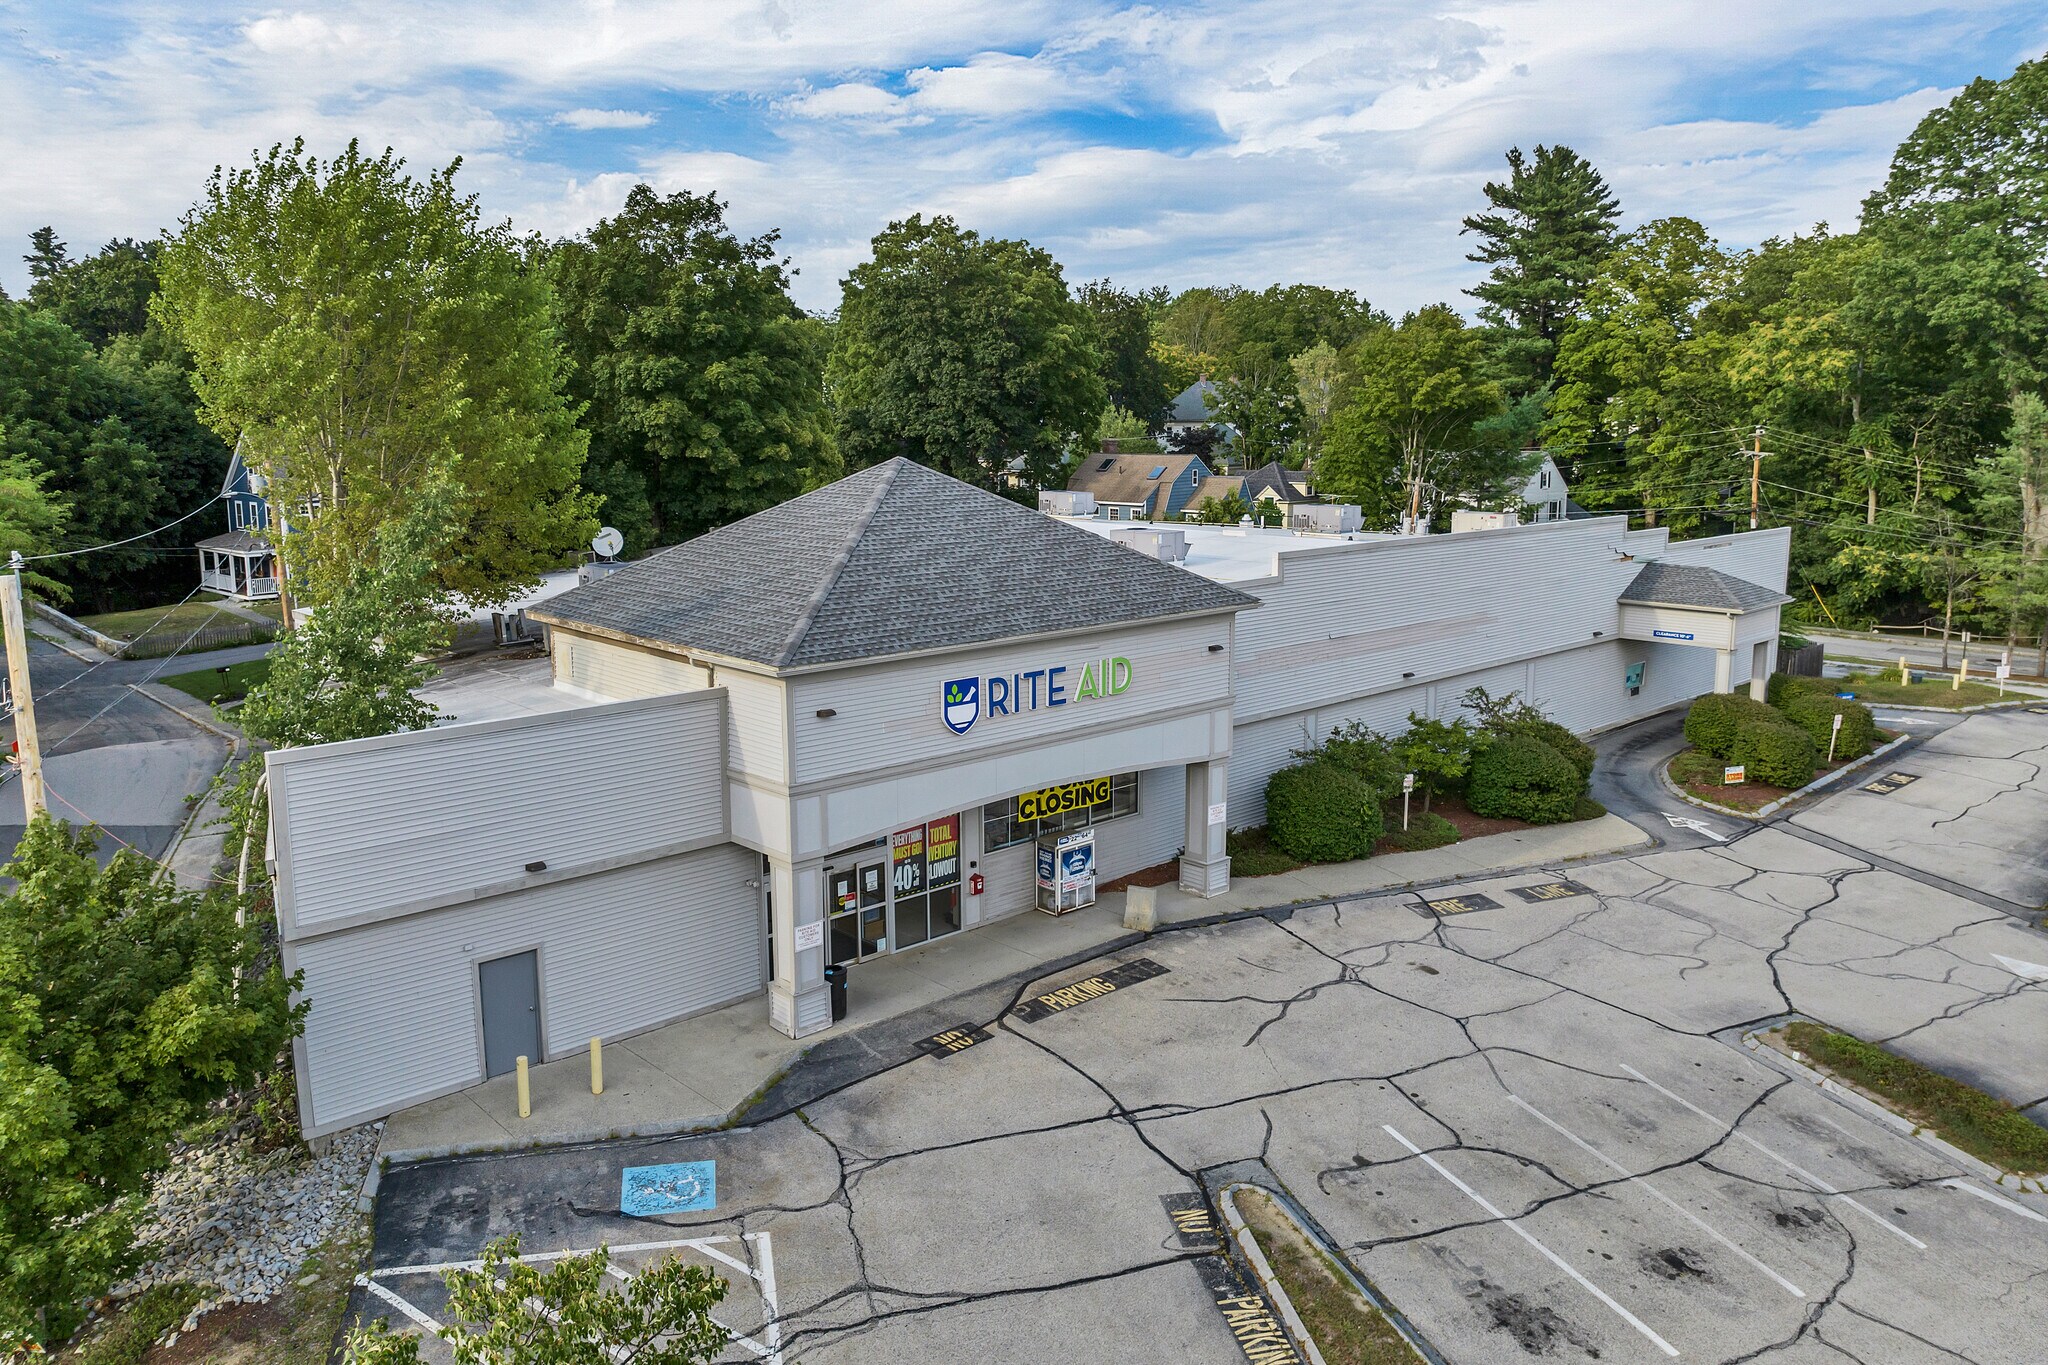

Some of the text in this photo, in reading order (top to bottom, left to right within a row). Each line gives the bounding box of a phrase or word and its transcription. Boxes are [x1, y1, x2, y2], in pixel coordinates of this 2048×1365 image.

[986, 656, 1133, 718] RITE AID
[1019, 781, 1109, 820] CLOSING
[930, 824, 952, 844] TOTAL
[928, 857, 957, 880] LOWOUT
[1428, 898, 1474, 915] FIRE
[1038, 977, 1116, 1011] PARKING
[933, 1031, 974, 1051] NO
[1170, 1208, 1213, 1234] NO
[1216, 1295, 1300, 1365] PARKIN
